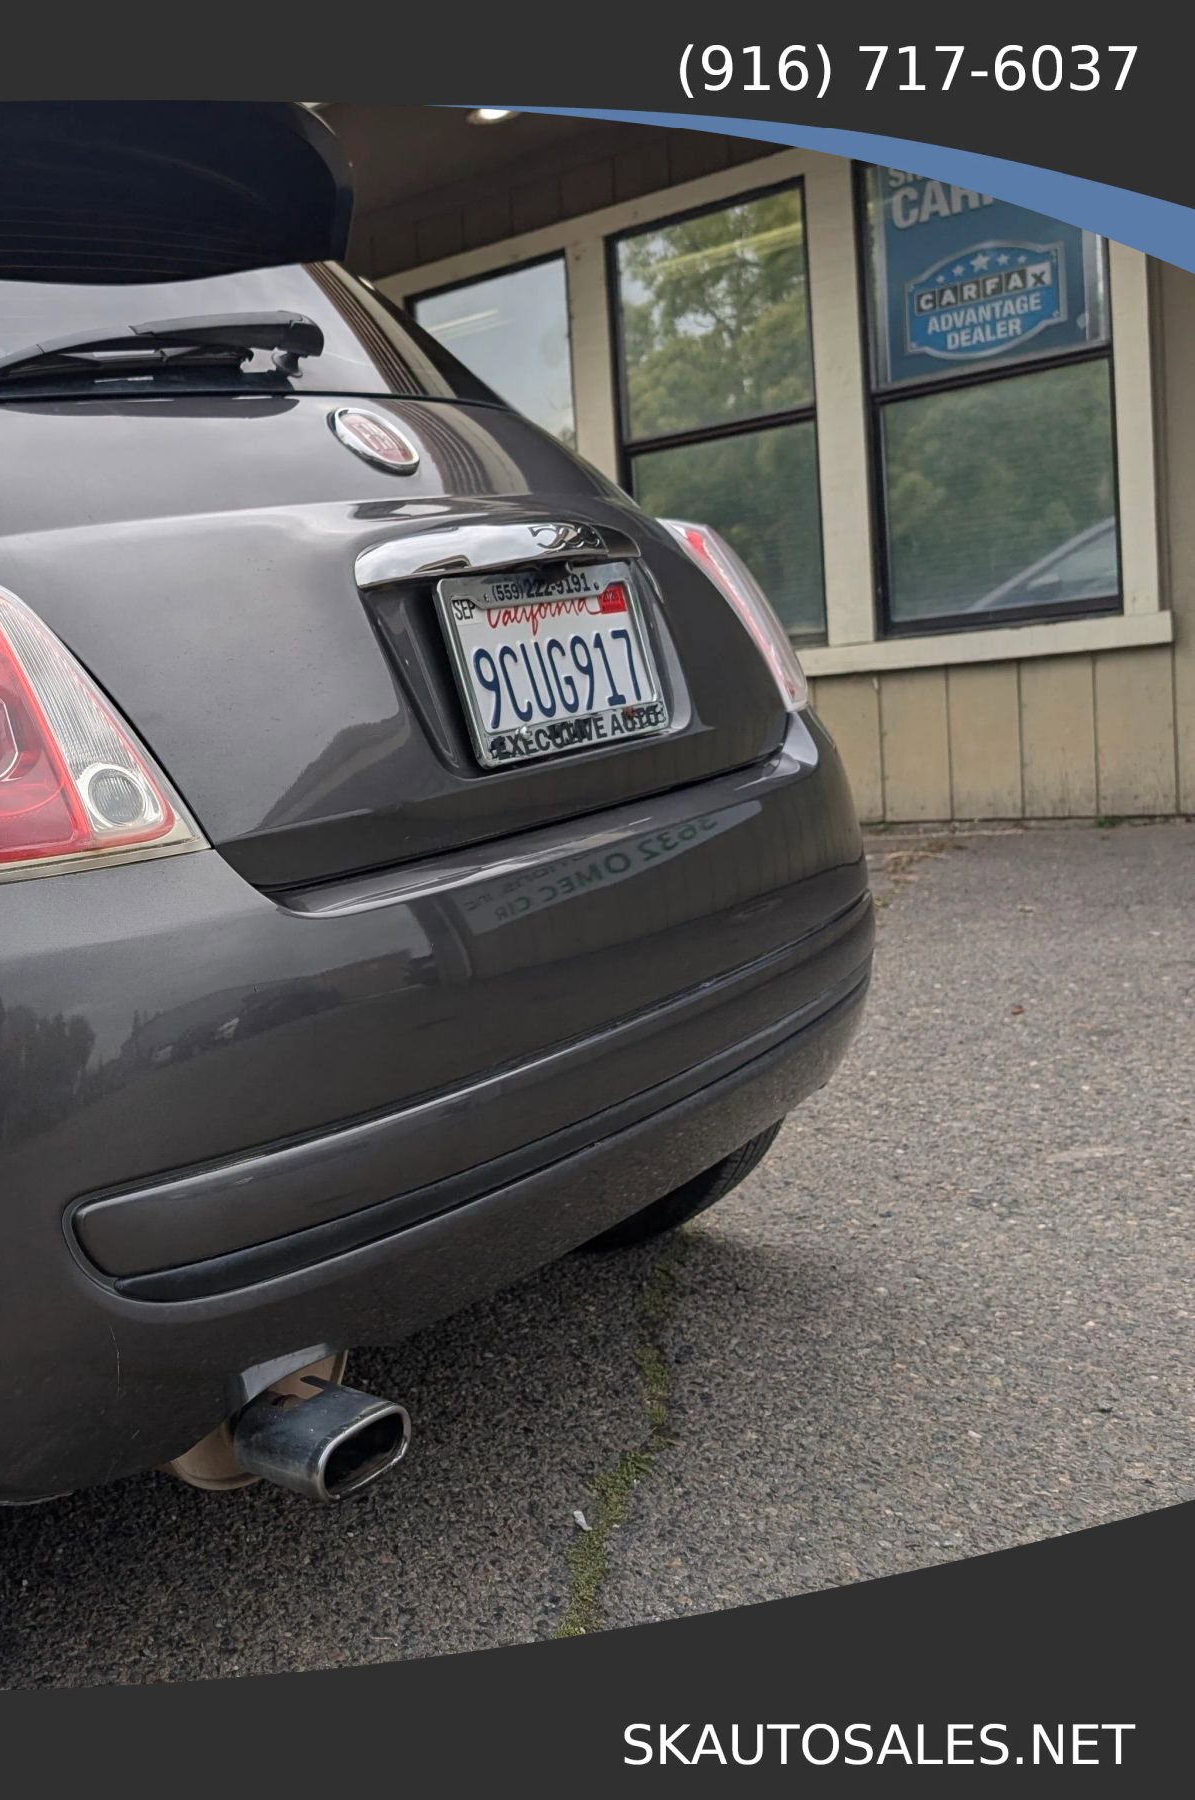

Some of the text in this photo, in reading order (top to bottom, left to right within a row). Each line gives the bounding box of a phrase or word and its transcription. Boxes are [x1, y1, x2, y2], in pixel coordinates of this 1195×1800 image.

[918, 269, 1046, 312] CARFAX
[927, 292, 1042, 335] ADVANTAGE
[947, 318, 1021, 350] DEALER
[454, 600, 475, 620] SEP
[472, 629, 642, 729] 9CUG917
